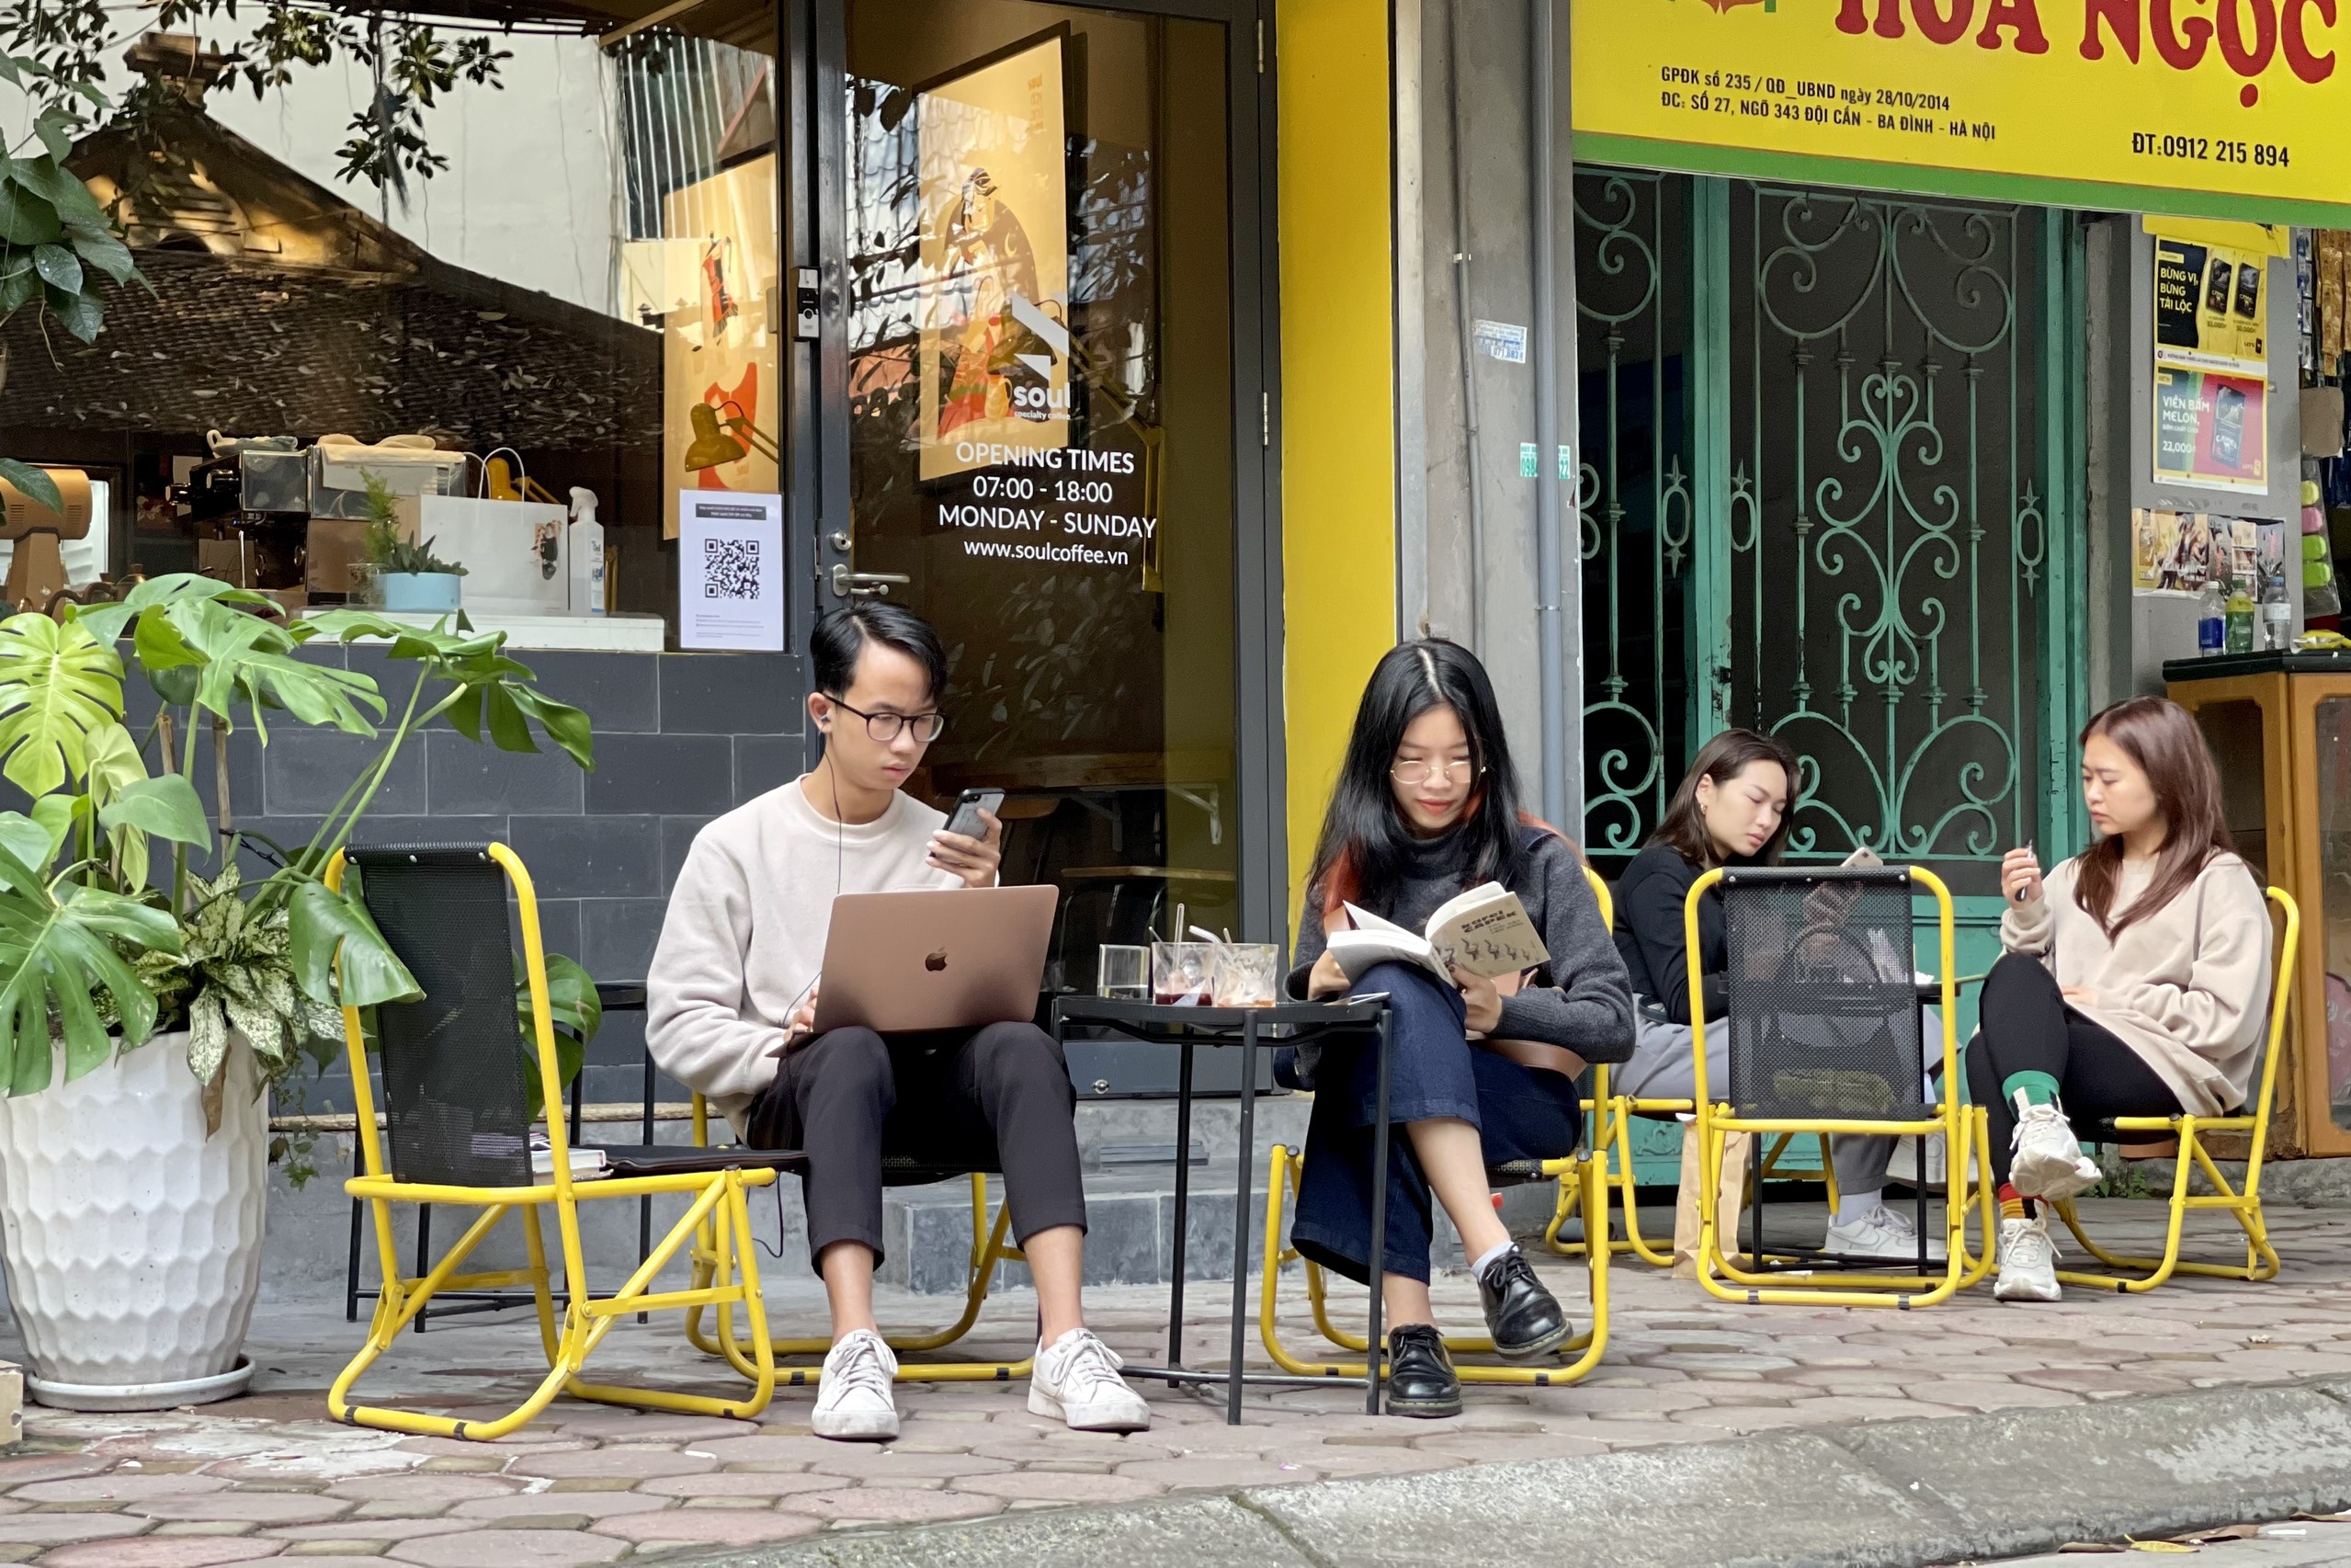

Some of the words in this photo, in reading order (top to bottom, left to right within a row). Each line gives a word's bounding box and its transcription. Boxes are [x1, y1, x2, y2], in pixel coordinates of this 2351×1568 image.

[2079, 0, 2337, 108] NGỌC
[1661, 65, 1700, 85] GPĐK
[1705, 70, 1721, 86] số
[1725, 73, 1751, 90] 235
[1840, 88, 1872, 106] ngày
[1876, 89, 1950, 111] 28/10/2014
[1661, 91, 1686, 108] ĐC:
[1691, 90, 1709, 110] SỐ
[1714, 97, 1735, 116] 27,
[1740, 99, 1769, 117] NGÕ
[1774, 103, 1800, 119] 343
[1804, 105, 1828, 125] ĐỘI
[1878, 114, 1895, 130] BA
[1899, 114, 1934, 133] ĐÌNH
[1949, 119, 1968, 137] HÀ
[1972, 121, 1996, 142] NỘI
[2131, 131, 2209, 160] ĐT:0912
[2216, 140, 2247, 164] 215
[2254, 143, 2289, 167] 894
[2175, 298, 2193, 313] LỘC
[1013, 381, 1071, 409] soul
[2163, 394, 2186, 410] VIÊN
[1014, 409, 1047, 421] specialty
[2163, 409, 2200, 426] MELON,
[956, 441, 1062, 470] OPENING
[1066, 449, 1134, 473] TIMES
[972, 475, 1034, 500] 07:00
[1055, 479, 1113, 504] 18:00
[938, 504, 1045, 531] MONDAY
[1063, 511, 1157, 539] SUNDAY
[964, 540, 1129, 565] www.soulcoffee.vn
